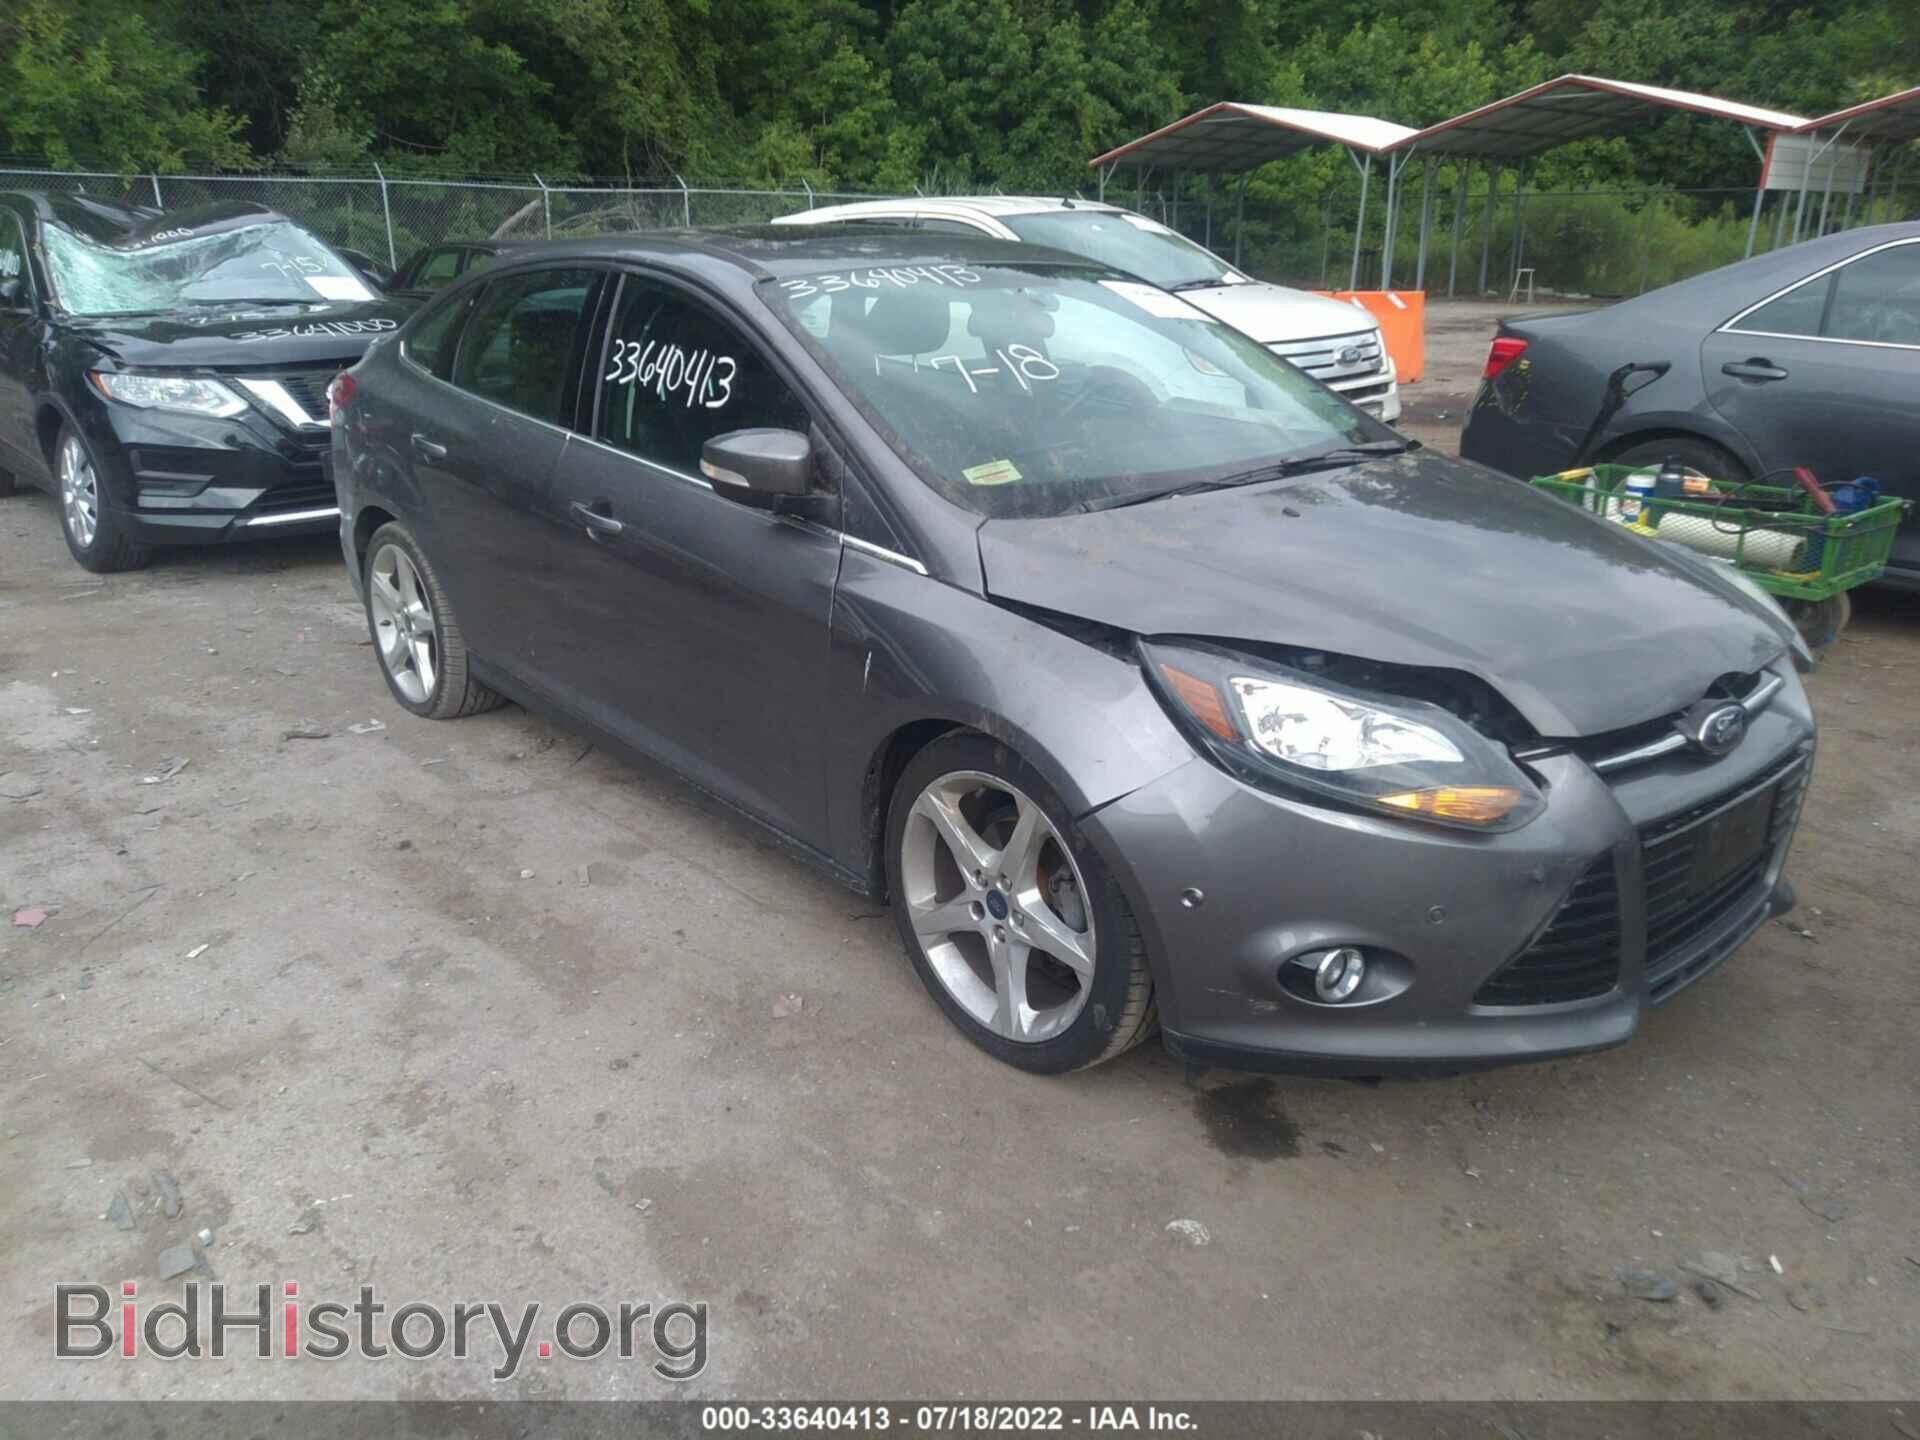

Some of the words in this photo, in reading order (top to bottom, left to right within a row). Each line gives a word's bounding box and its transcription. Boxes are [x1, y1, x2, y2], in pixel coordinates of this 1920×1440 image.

[780, 263, 982, 300] 33640413
[229, 317, 398, 345] 33641000
[605, 338, 737, 409] 33640413
[930, 343, 1060, 396] 7-18
